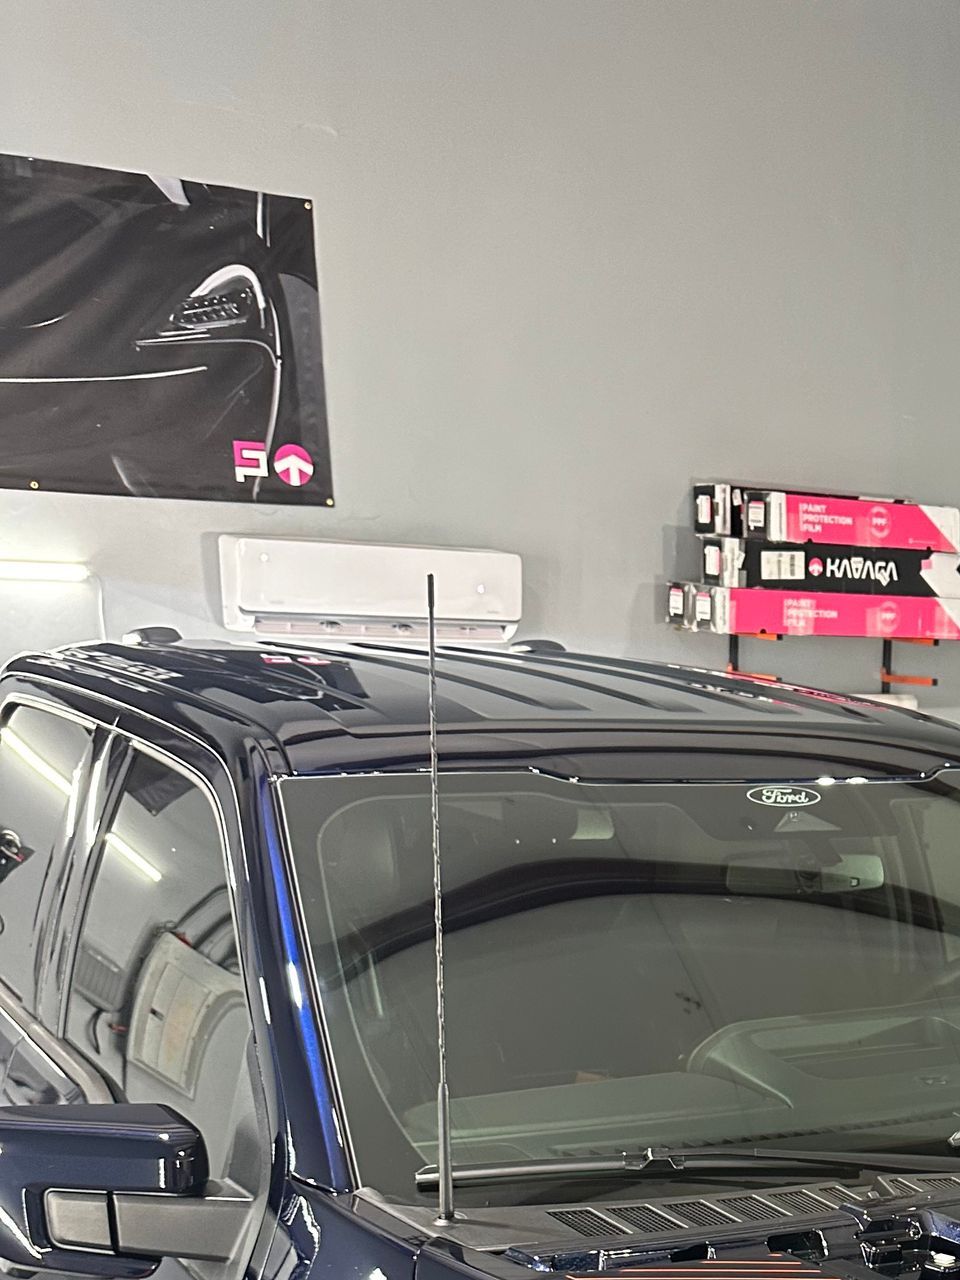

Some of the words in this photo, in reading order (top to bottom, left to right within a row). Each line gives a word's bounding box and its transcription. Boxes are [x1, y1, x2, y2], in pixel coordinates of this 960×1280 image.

[802, 503, 827, 513] PAINT
[802, 513, 853, 526] PROTECTION
[802, 523, 822, 533] FILM
[761, 788, 809, 803] Ford
